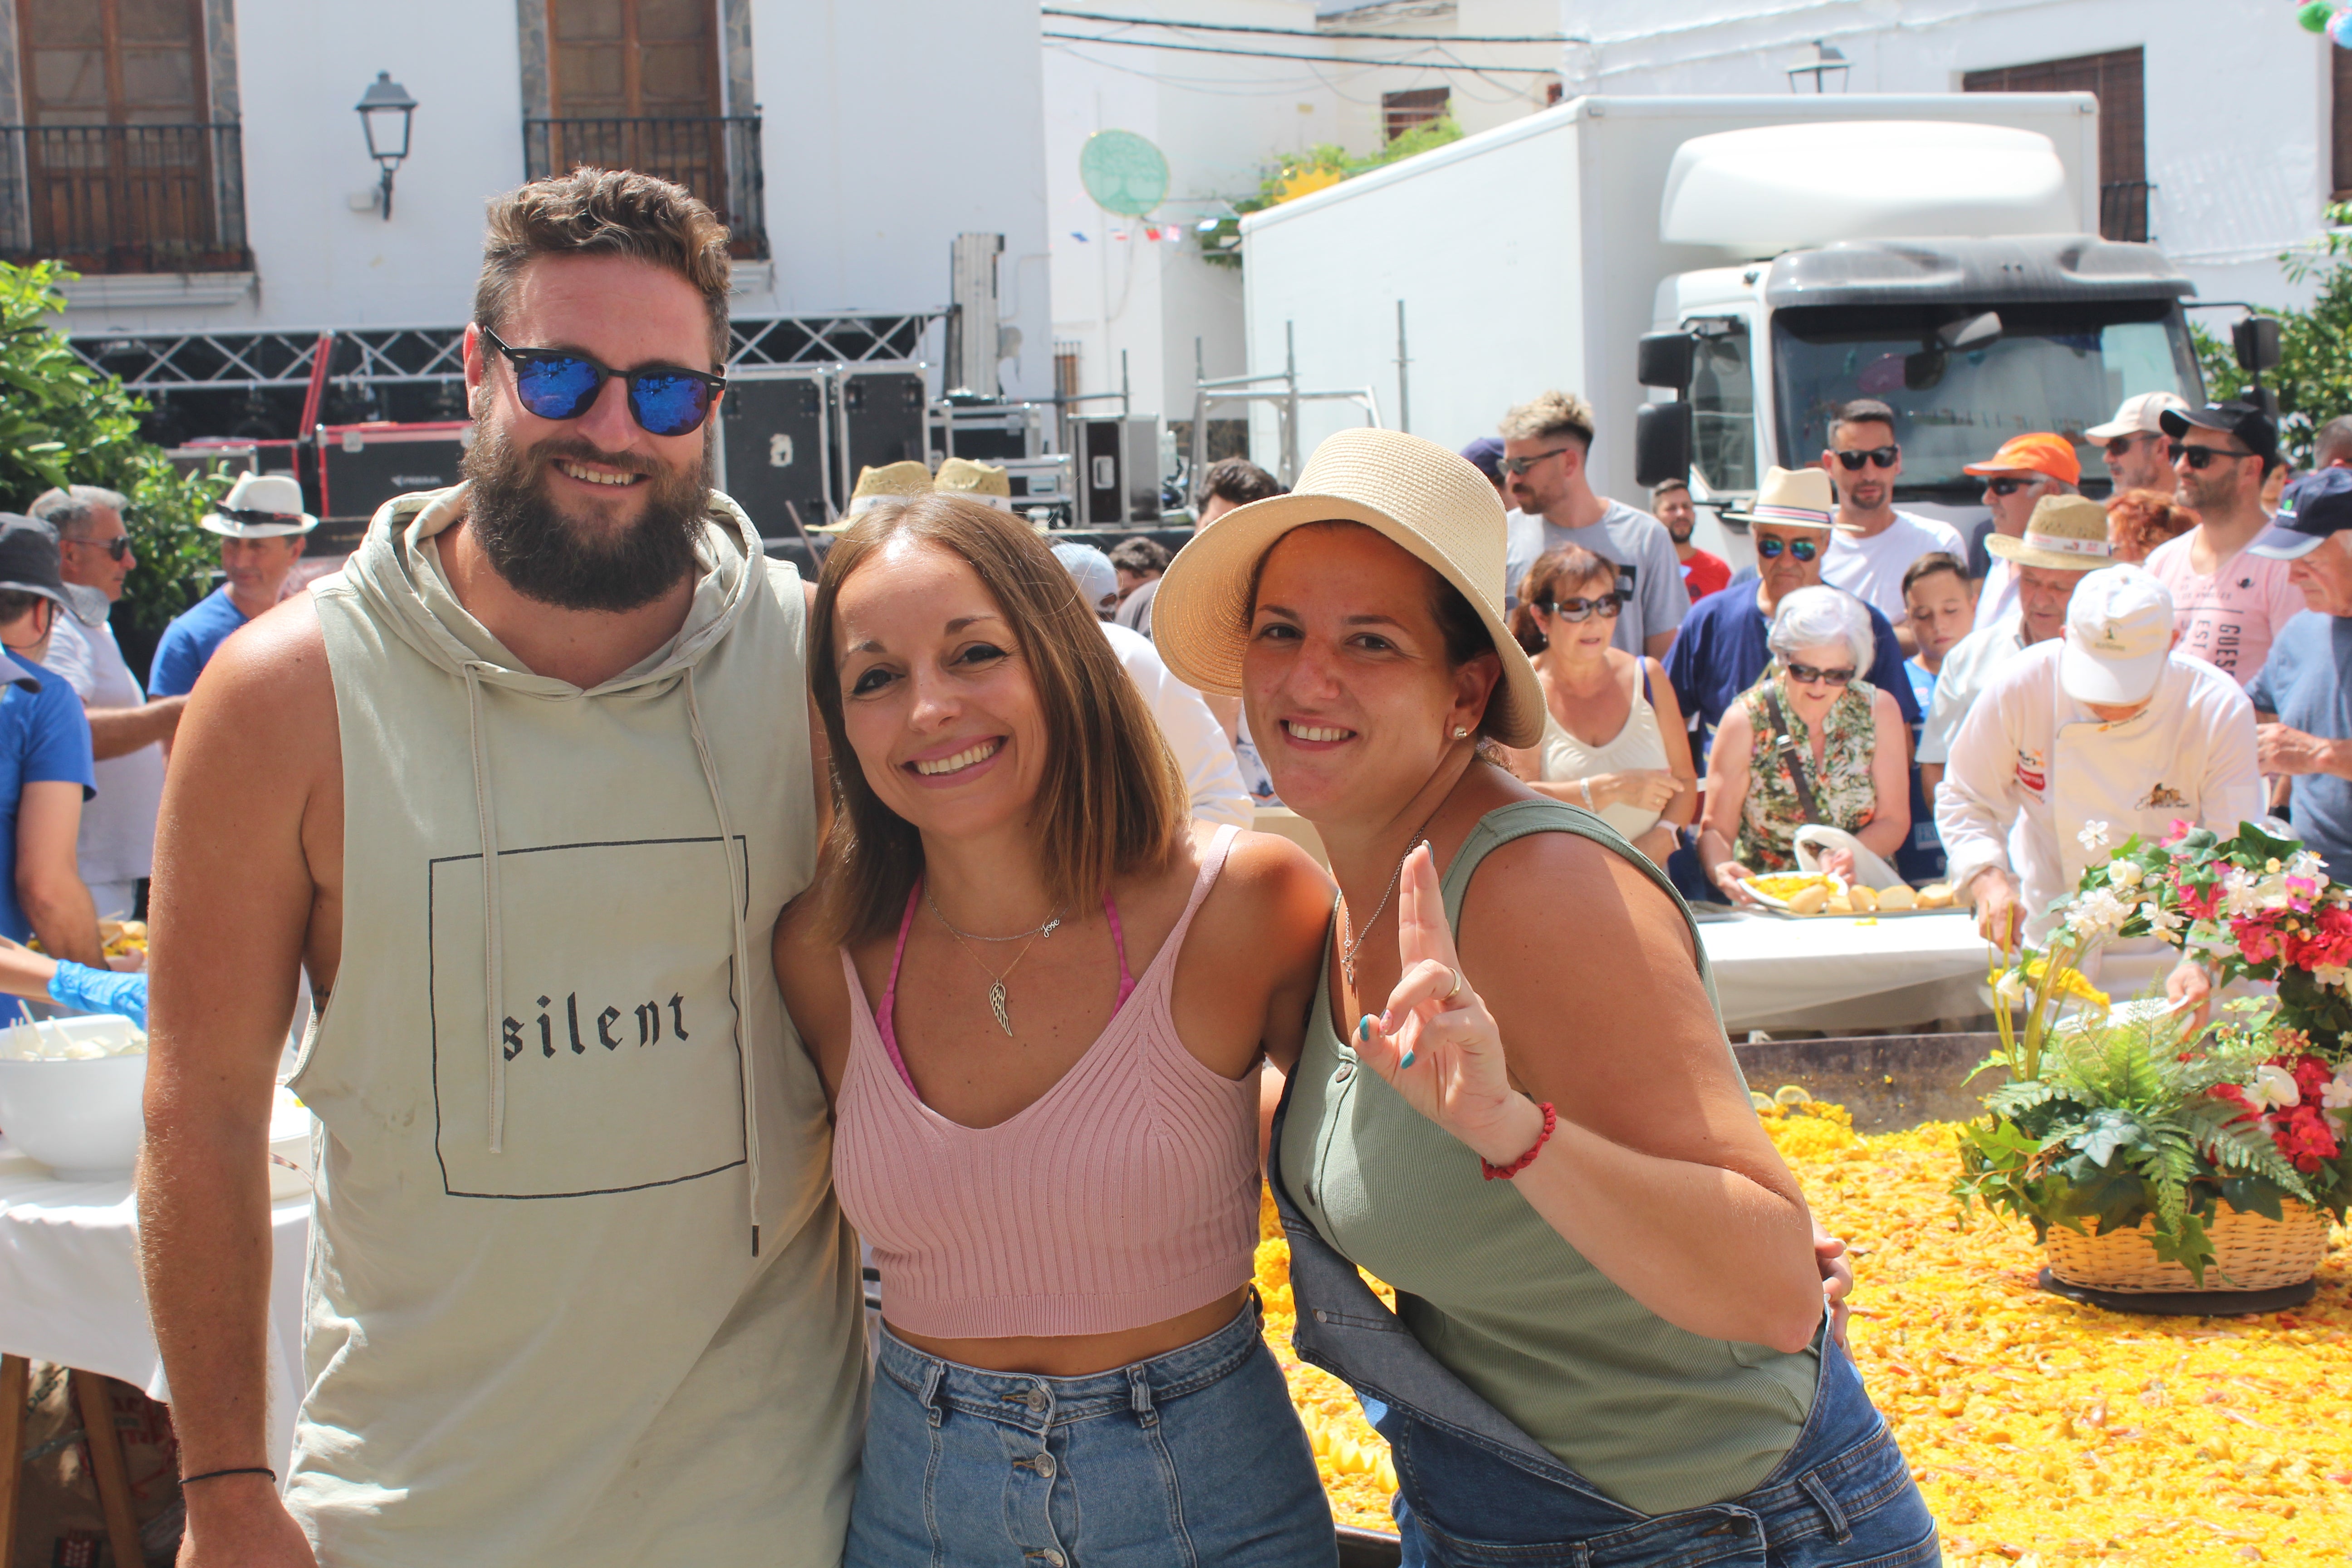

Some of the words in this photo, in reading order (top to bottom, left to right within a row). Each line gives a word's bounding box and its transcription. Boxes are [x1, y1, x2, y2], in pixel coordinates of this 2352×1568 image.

[2193, 620, 2210, 648] EST
[1041, 919, 1060, 938] Jose
[502, 991, 689, 1061] silent
